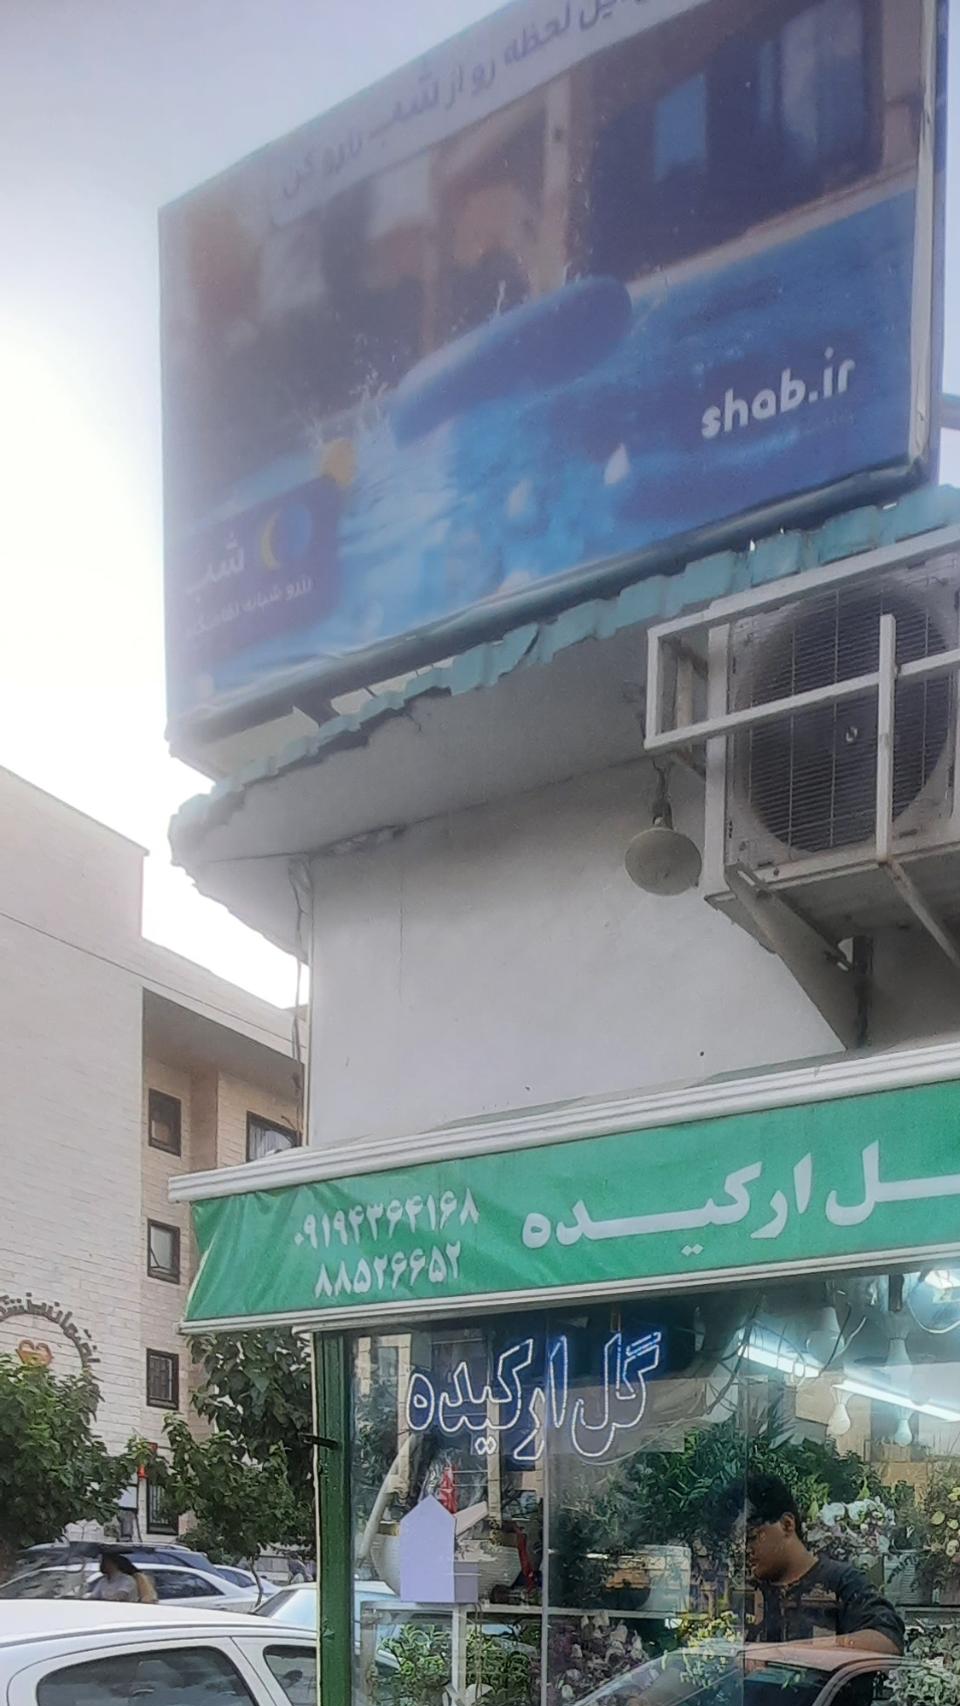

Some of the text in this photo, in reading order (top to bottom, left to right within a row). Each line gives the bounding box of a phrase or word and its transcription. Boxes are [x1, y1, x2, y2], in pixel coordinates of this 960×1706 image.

[702, 347, 856, 440] shab.ir
[522, 1152, 813, 1258] ارکیده
[315, 1240, 461, 1298] ۸۸۵۲۶۶۵۲
[406, 1332, 662, 1461] گل ارکیده
